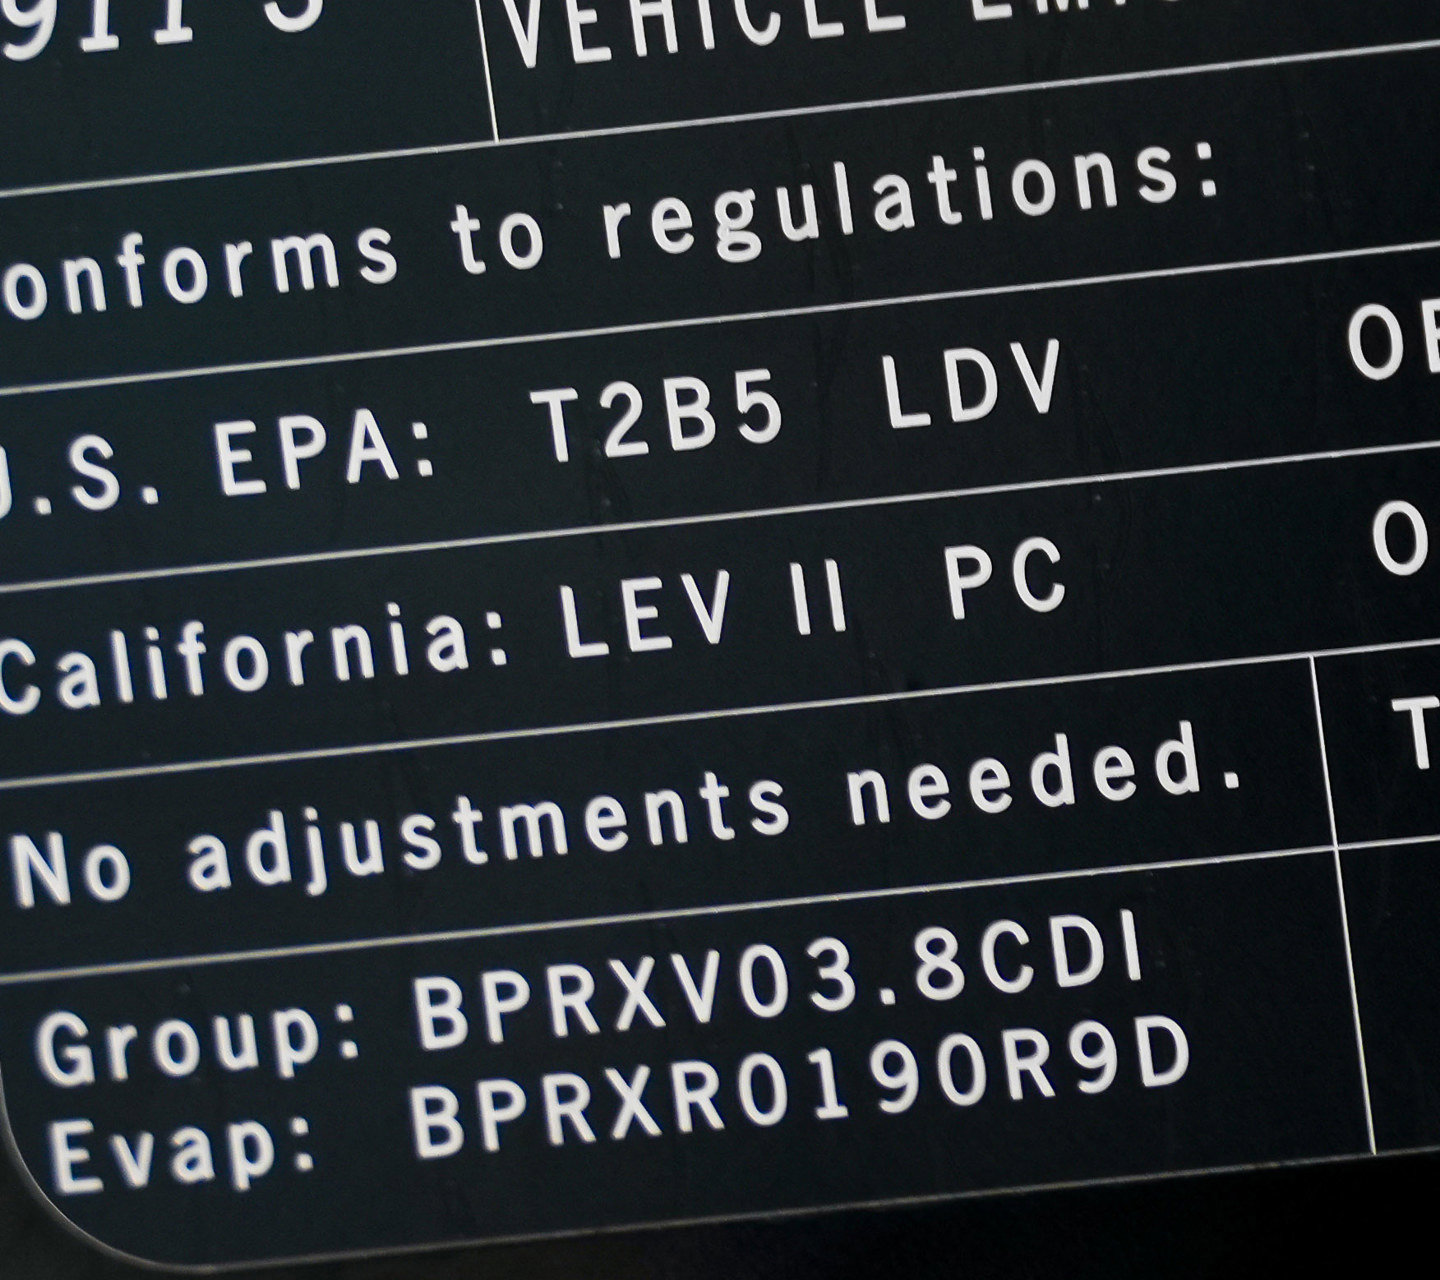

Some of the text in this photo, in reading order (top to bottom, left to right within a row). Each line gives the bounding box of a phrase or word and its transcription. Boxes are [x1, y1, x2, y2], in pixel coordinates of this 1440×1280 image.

[448, 202, 546, 277] to
[600, 139, 1219, 265] regulations:
[212, 406, 435, 499] EPA:
[527, 366, 784, 465] T2B5
[880, 336, 1062, 431] LDV
[557, 567, 732, 661] LEV
[787, 557, 849, 638] II
[942, 534, 1068, 622] PC
[8, 718, 1242, 910] No adjustments needed.
[35, 907, 1144, 1089] Group: BPRXV03.8CDI
[48, 1013, 1192, 1196] Evap: BPRXR0190R9D
